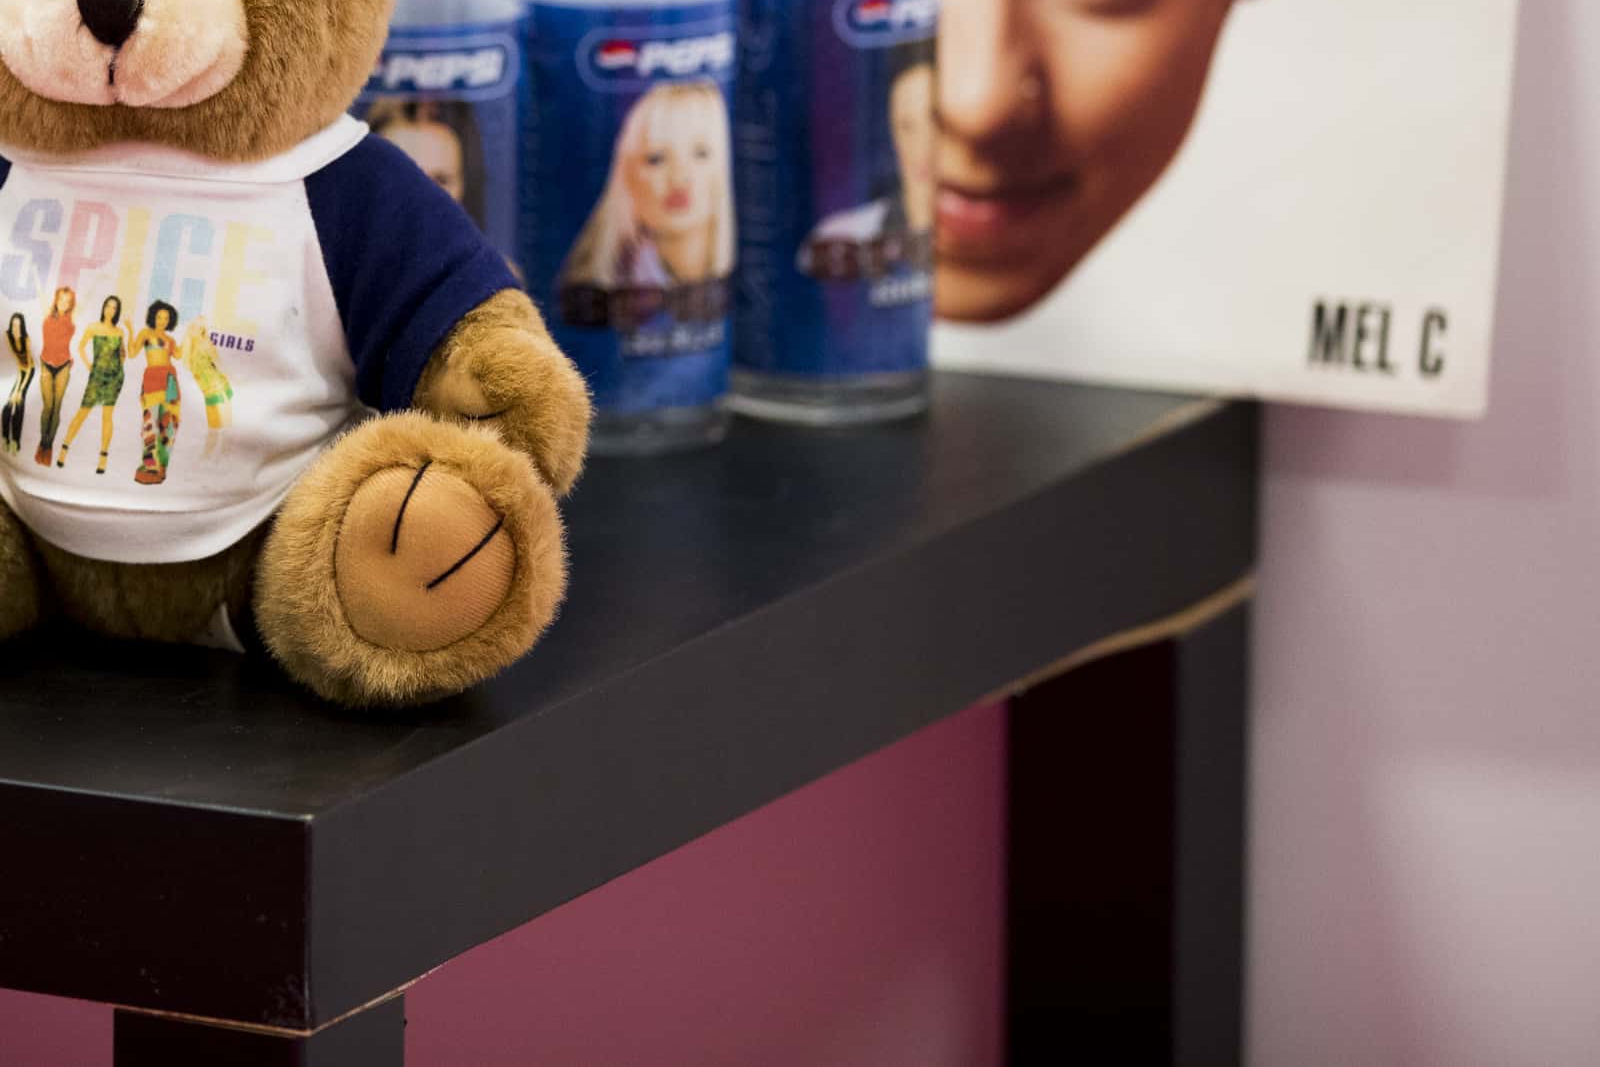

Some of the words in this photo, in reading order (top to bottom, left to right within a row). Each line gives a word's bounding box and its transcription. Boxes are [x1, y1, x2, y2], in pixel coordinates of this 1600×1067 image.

[0, 198, 275, 335] SPICE
[209, 331, 255, 352] GIRLS
[1308, 300, 1396, 374] MEL
[1418, 306, 1448, 379] C
